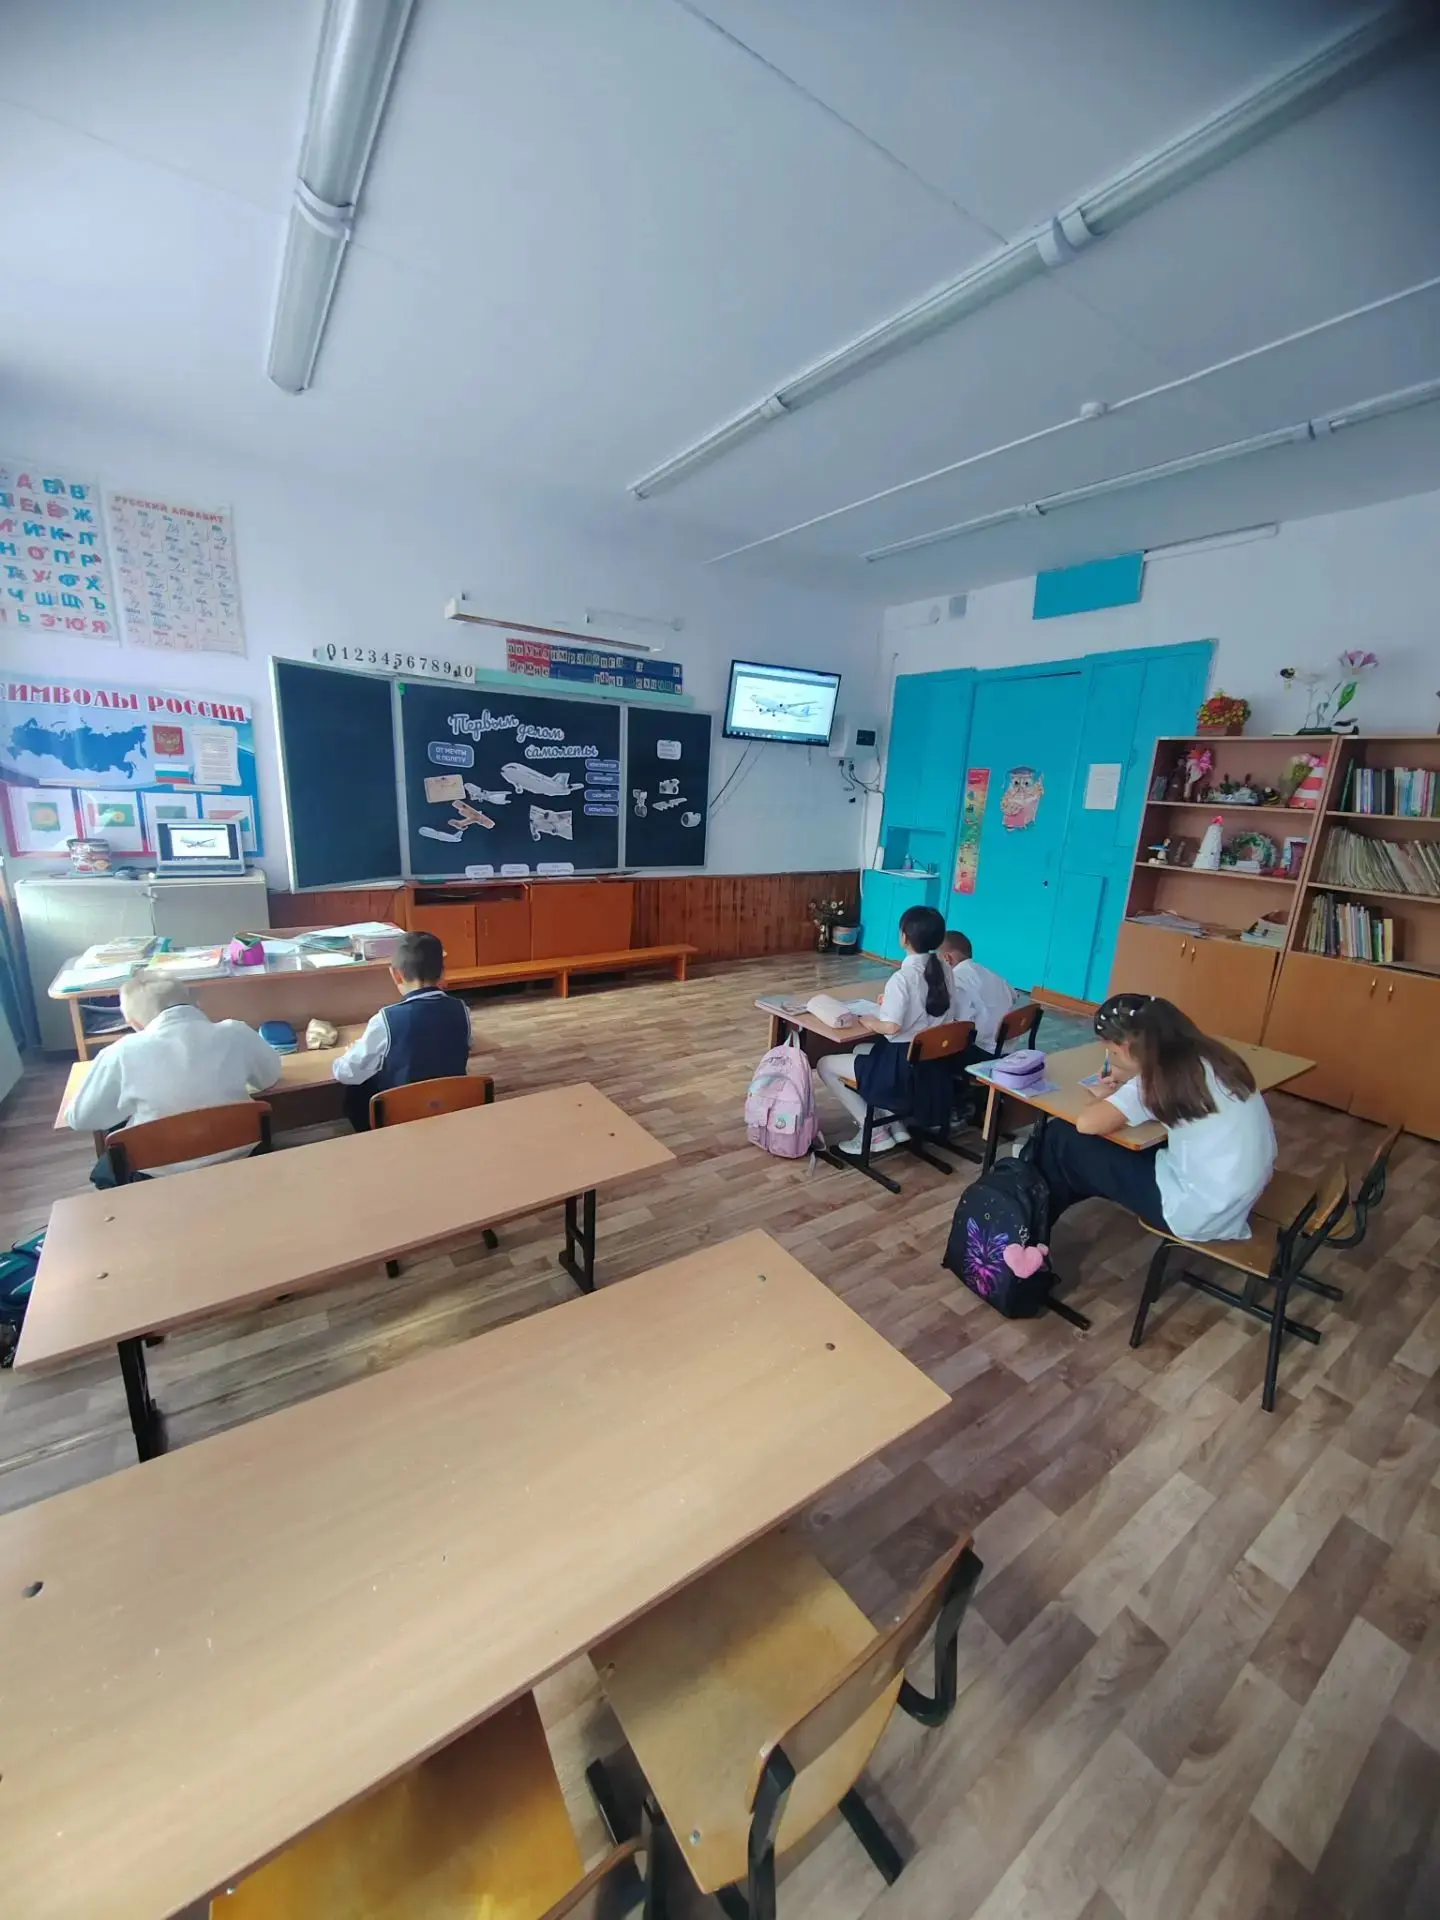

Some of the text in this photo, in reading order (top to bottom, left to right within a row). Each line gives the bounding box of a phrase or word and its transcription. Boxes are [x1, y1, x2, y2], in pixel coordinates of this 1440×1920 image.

[72, 507, 93, 523] Ж
[50, 526, 64, 541] К
[28, 546, 45, 560] О
[54, 550, 70, 565] П
[81, 554, 95, 567] Р
[85, 576, 100, 591] Х
[8, 588, 24, 602] Ч
[35, 592, 53, 606] Ш
[89, 596, 106, 610] Ъ
[65, 617, 85, 631] Ю
[92, 620, 107, 633] Я
[148, 695, 246, 722] РОССИИ
[448, 709, 519, 741] Первым
[516, 724, 565, 743] делом
